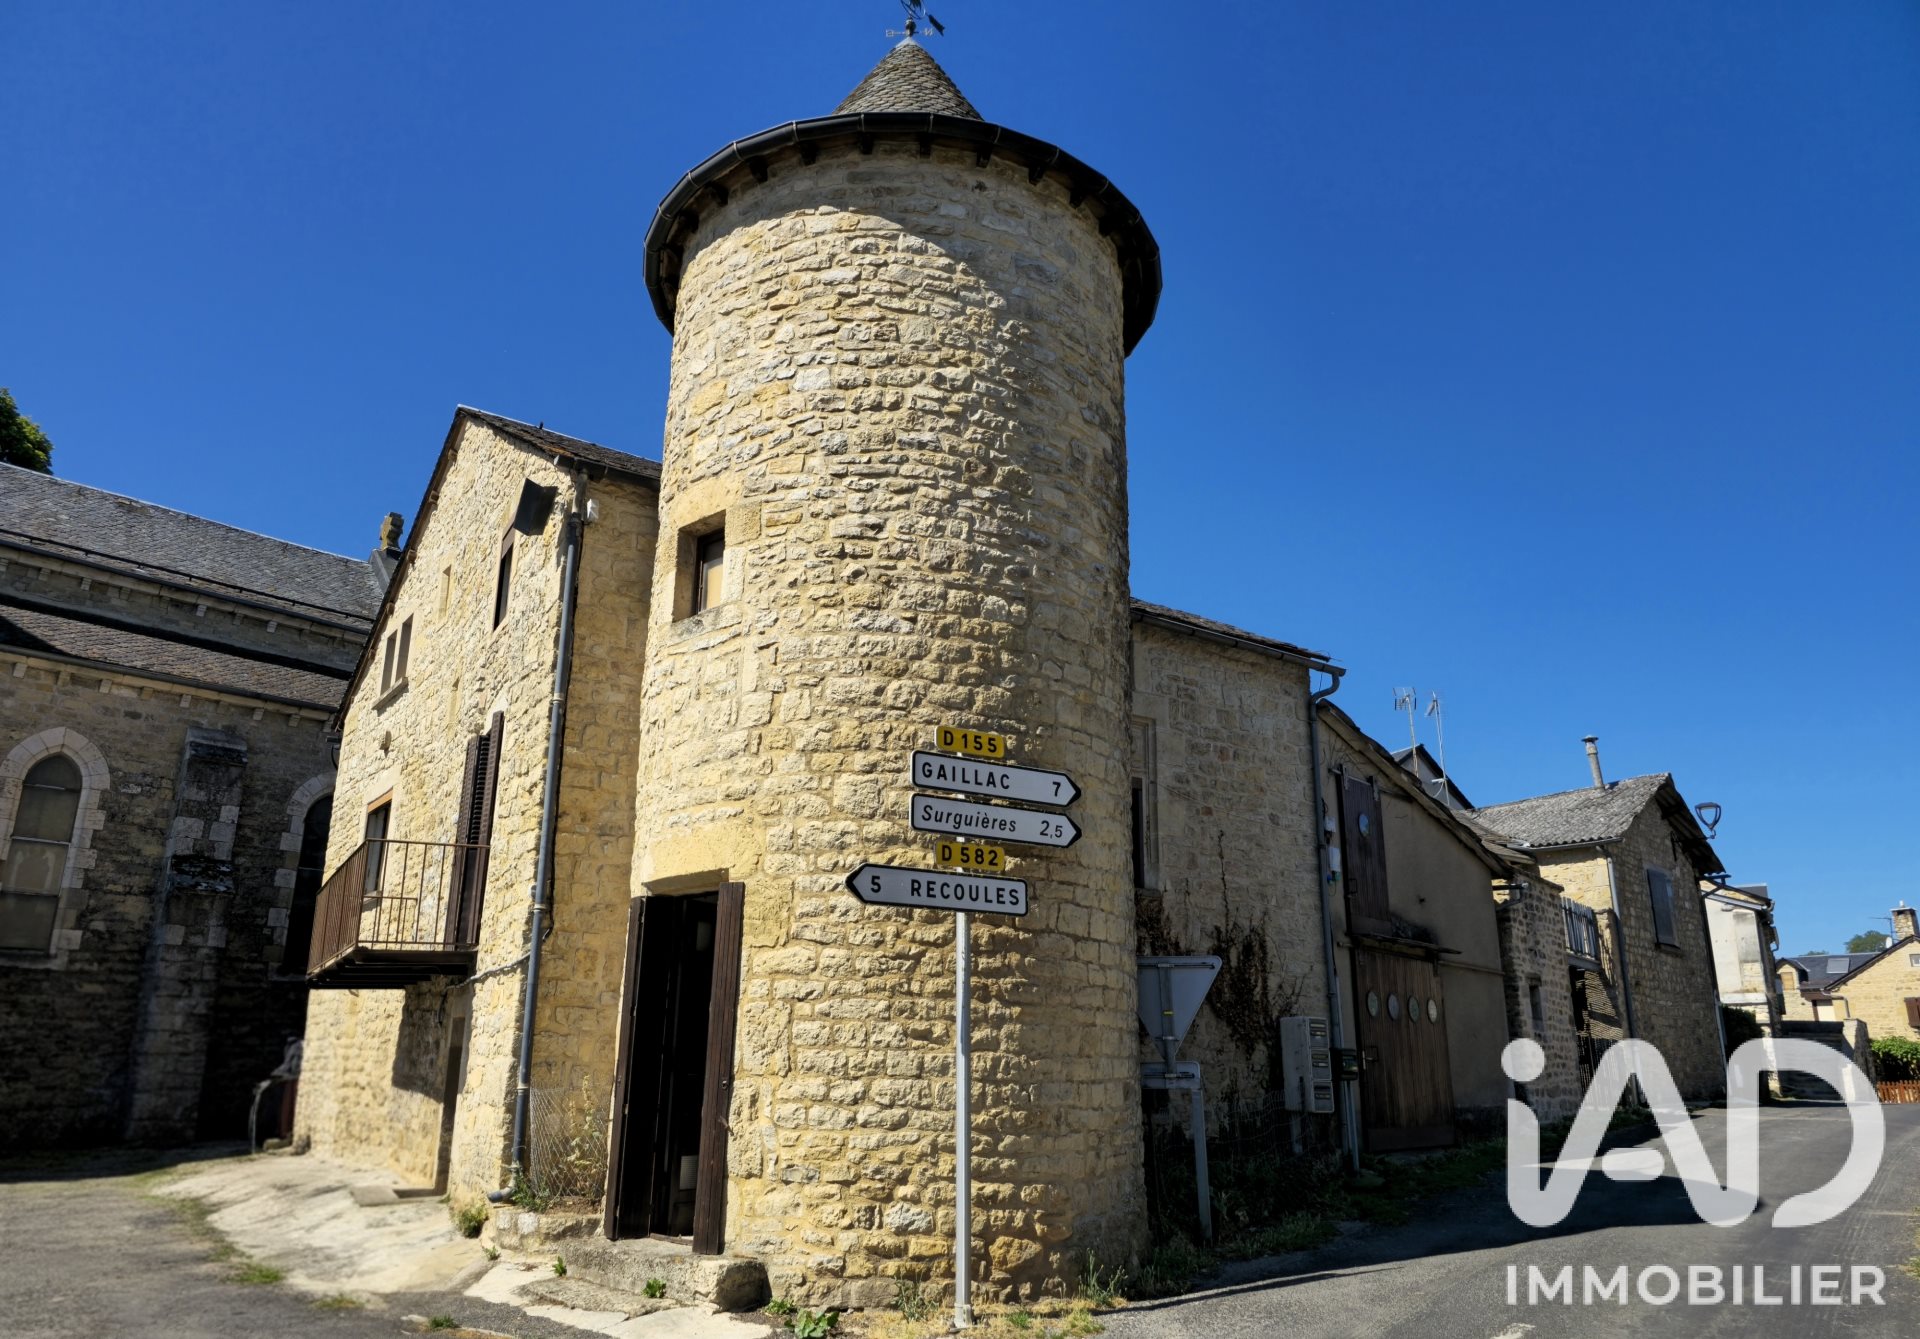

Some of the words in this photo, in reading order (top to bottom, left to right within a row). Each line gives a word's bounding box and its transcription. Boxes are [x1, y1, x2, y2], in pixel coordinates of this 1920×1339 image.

[943, 730, 954, 746] D
[961, 733, 997, 753] 155
[921, 762, 1010, 790] GAILLAC
[1052, 781, 1062, 797] 7
[921, 804, 1017, 833] Surguières
[1039, 820, 1063, 839] 2,5
[941, 844, 953, 862] D
[960, 846, 999, 867] 582
[870, 875, 882, 893] 5
[910, 879, 1020, 906] RECOULES
